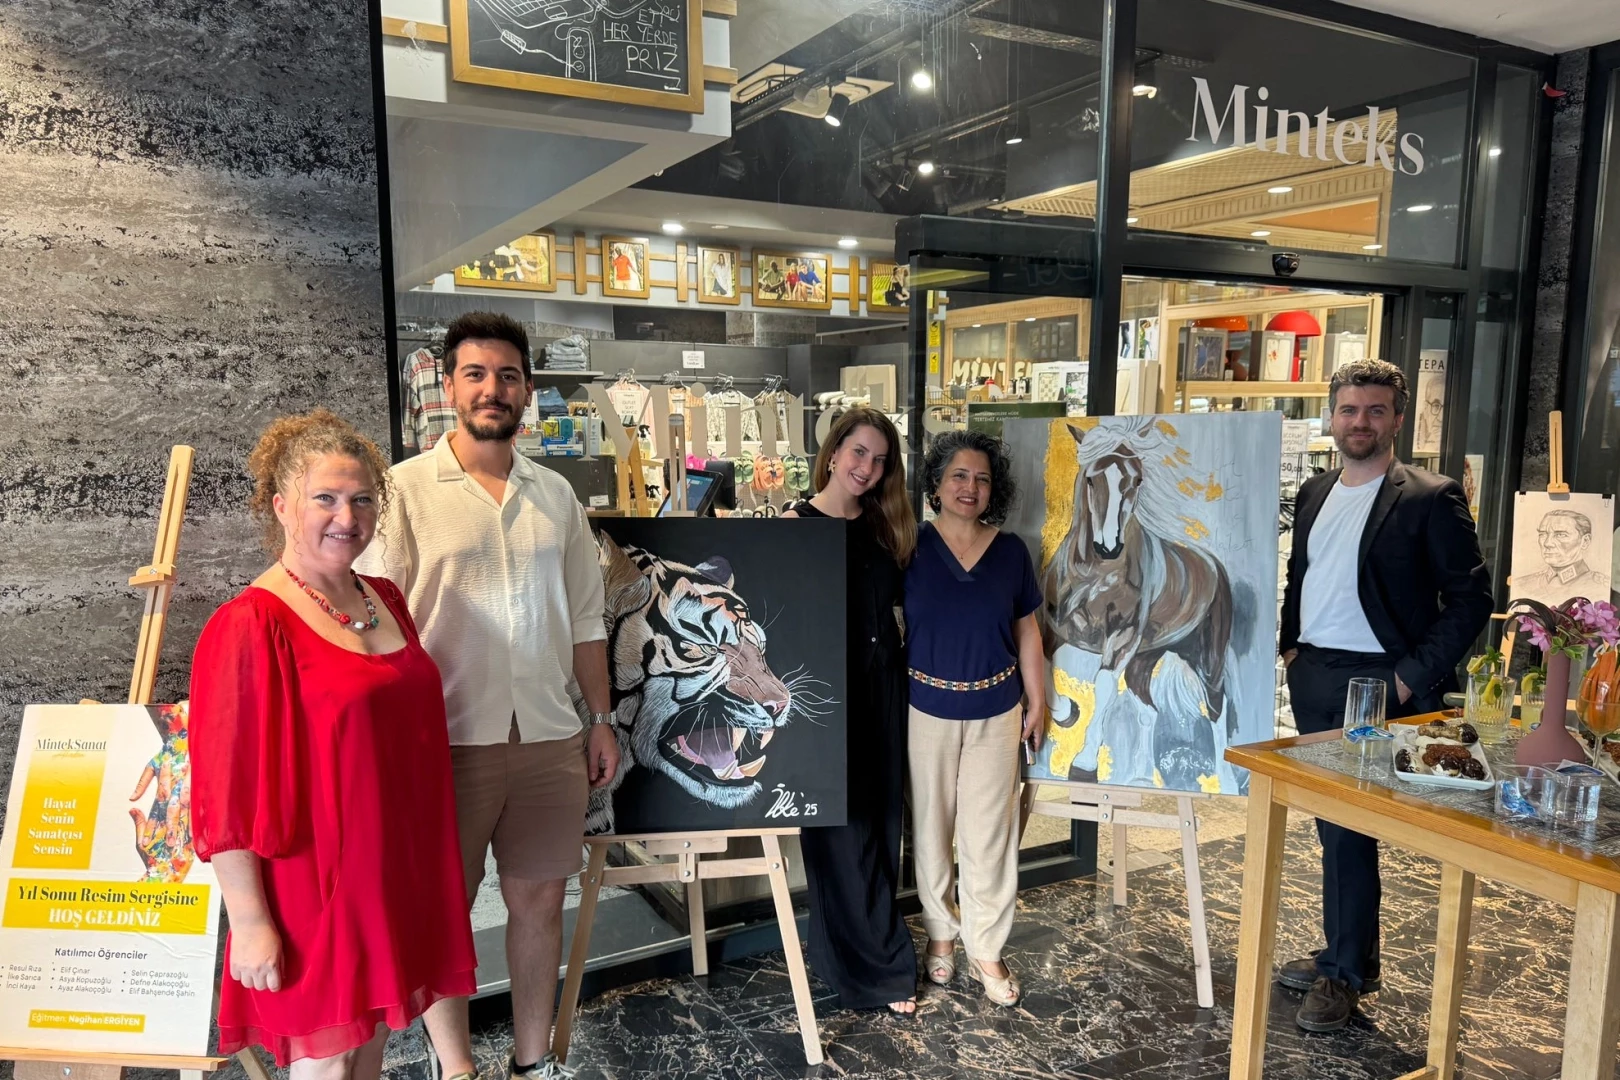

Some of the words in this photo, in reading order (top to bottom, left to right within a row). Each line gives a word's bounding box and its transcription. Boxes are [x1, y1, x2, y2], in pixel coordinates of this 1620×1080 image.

[603, 20, 632, 41] HER
[637, 26, 677, 46] YERDE
[1185, 76, 1424, 176] Minteks
[35, 738, 107, 750] MintekSanat
[43, 797, 77, 811] Hayat
[41, 814, 75, 825] Senin
[28, 827, 83, 843] Sanatçısı
[33, 844, 73, 856] Sensin
[18, 885, 38, 900] Yıl
[40, 886, 77, 901] Sonu
[80, 887, 126, 903] Resim
[129, 889, 199, 909] Sergisine
[49, 907, 83, 928] HOŞ
[85, 907, 161, 927] GELDİNİZ
[54, 947, 96, 958] Katılımcı
[98, 947, 148, 960] Öğrenciler
[60, 966, 71, 974] Elif
[131, 969, 148, 977] Selin
[59, 976, 76, 984] Asya
[130, 978, 151, 986] Defne
[19, 982, 36, 991] Kaya
[129, 987, 141, 995] Elif
[104, 1015, 140, 1027] ERGİYEN
